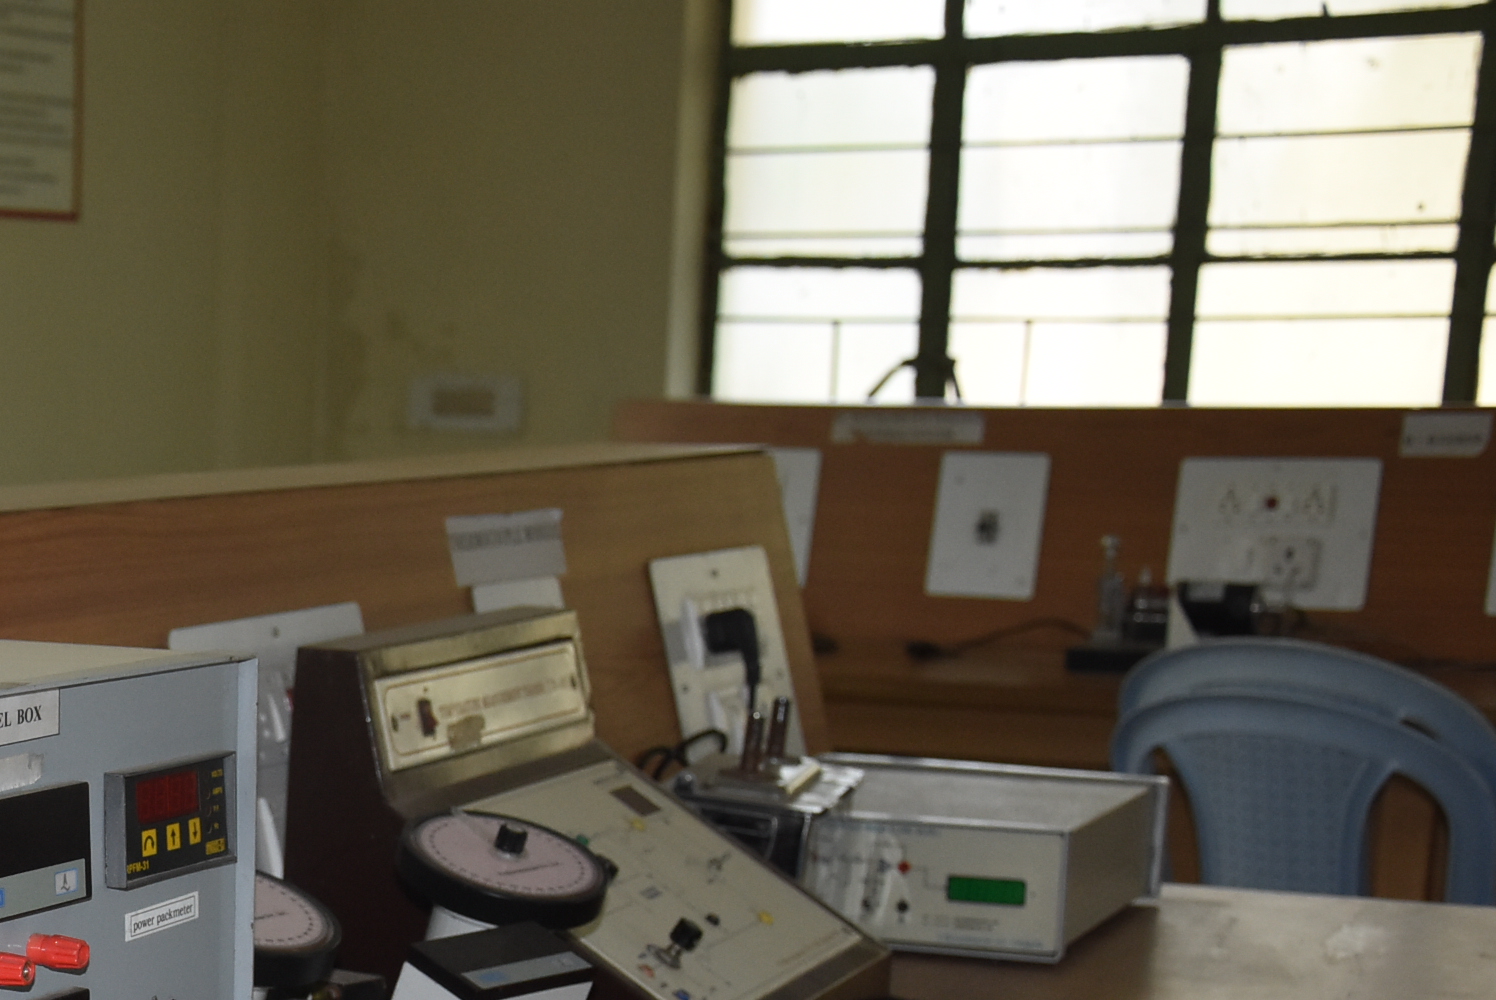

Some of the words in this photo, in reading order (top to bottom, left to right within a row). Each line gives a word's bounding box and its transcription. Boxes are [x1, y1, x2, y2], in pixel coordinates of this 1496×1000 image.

[17, 705, 42, 725] BOX
[133, 916, 155, 933] power
[156, 904, 193, 926] packmeter
